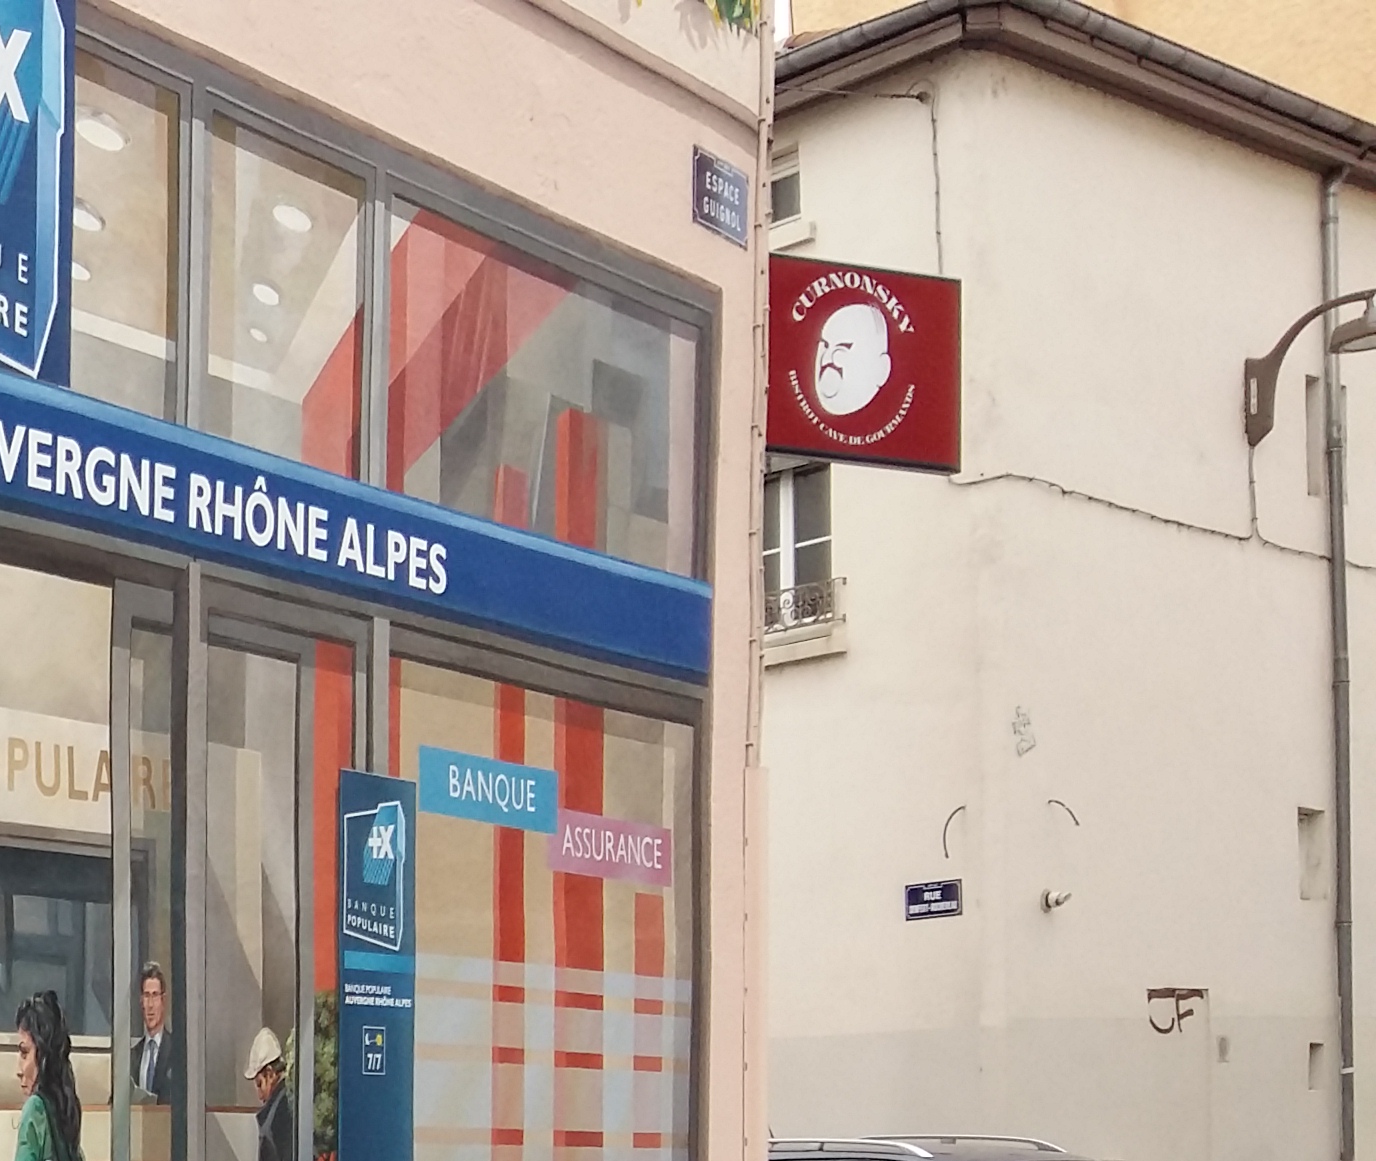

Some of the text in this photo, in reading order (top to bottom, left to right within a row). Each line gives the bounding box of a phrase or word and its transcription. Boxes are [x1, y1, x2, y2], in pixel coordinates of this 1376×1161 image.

[705, 171, 740, 206] ESPACE
[703, 196, 741, 232] GUIGNOL
[791, 271, 915, 333] CURNONSKY
[788, 369, 916, 446] BISTROT CAVE DE GOURMANDS
[188, 474, 328, 562] RHÔNE
[337, 516, 449, 596] ALPES
[448, 764, 536, 812] BANQUE
[561, 823, 663, 869] ASSURANCE
[347, 898, 395, 919] BANQUE
[923, 890, 942, 901] RUE
[347, 914, 395, 939] POPULAIRE
